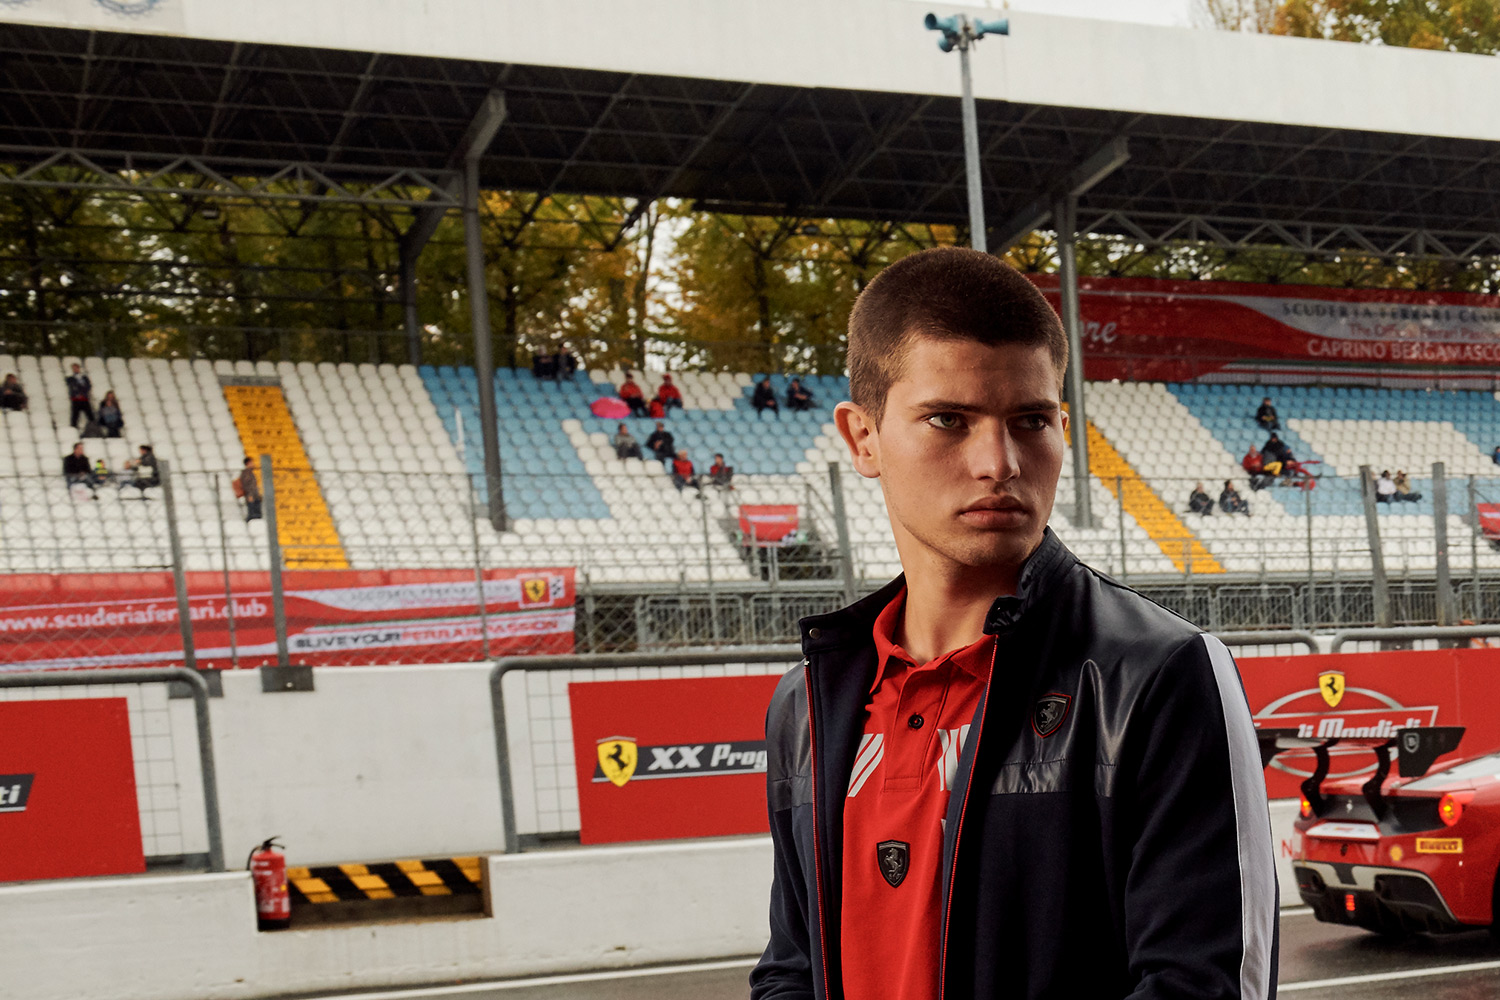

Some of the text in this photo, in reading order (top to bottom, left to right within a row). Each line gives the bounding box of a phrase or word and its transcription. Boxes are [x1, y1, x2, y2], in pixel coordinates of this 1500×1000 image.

[1307, 339, 1387, 358] CAPRINO
[0, 598, 267, 631] ww.scuderiaferari.club
[647, 743, 767, 771] XX Prog
